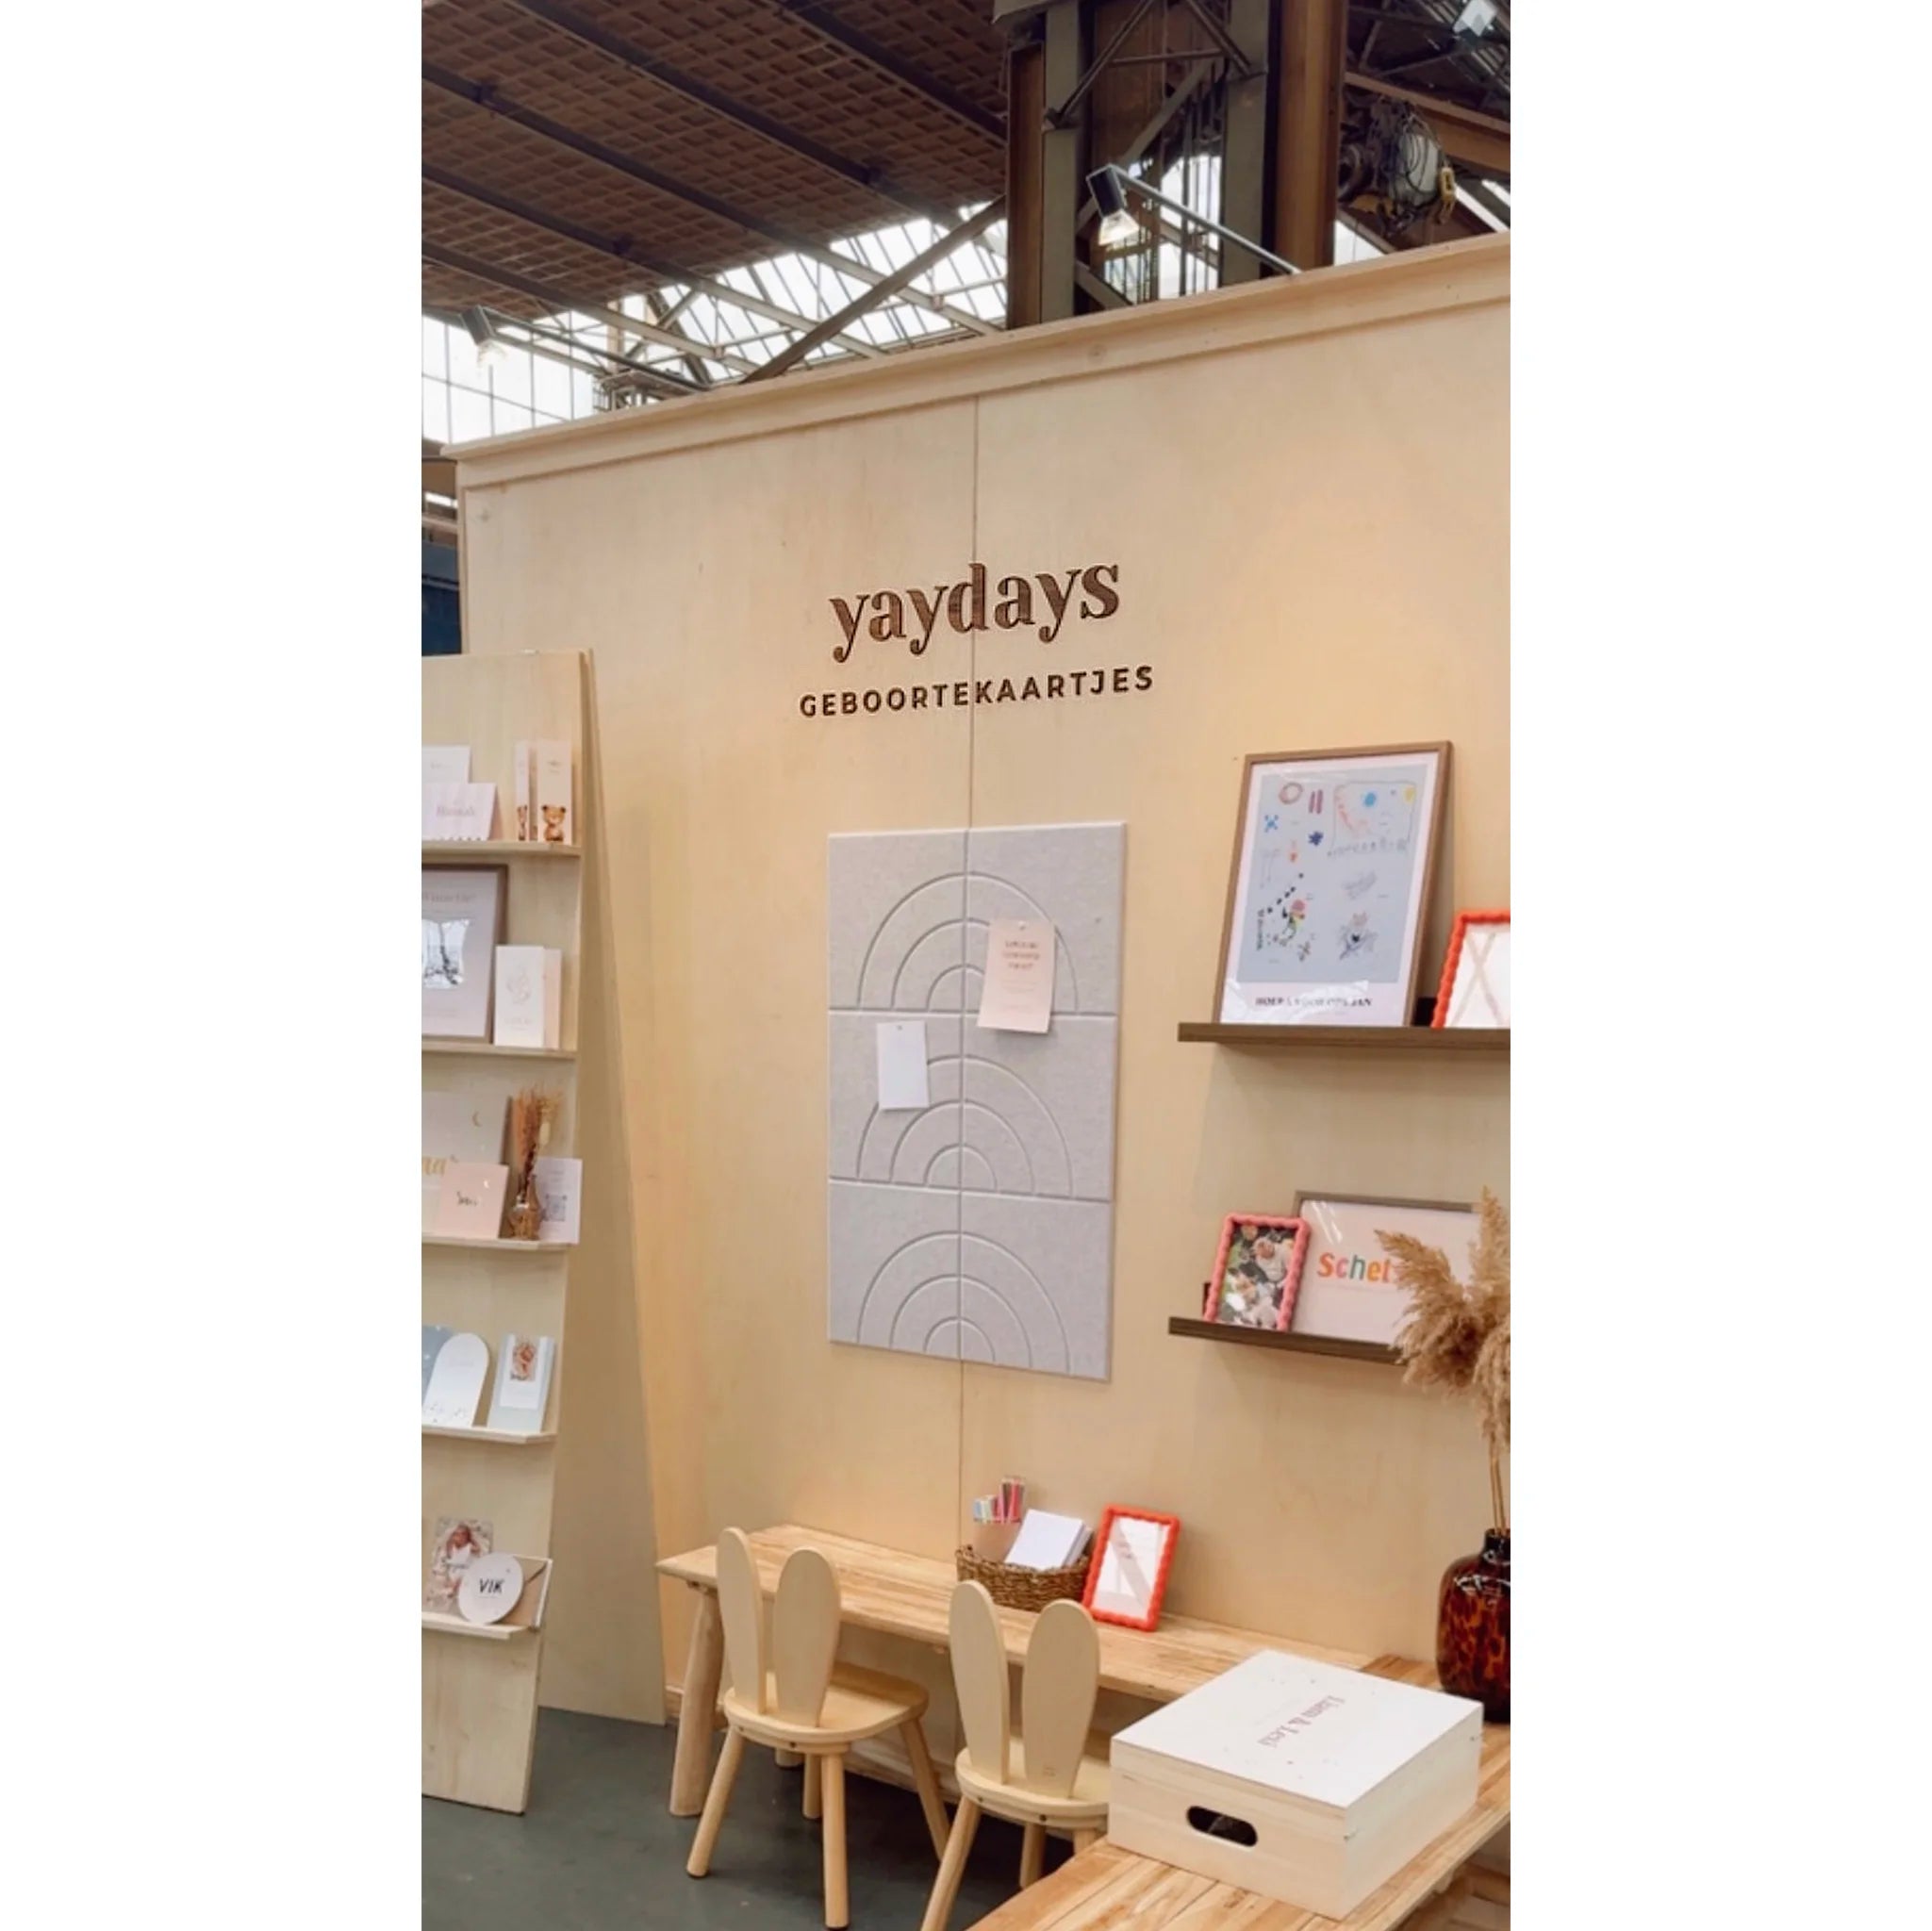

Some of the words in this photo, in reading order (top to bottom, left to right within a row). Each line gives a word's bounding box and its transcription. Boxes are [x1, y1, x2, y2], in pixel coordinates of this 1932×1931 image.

[829, 563, 1120, 663] yaydays
[800, 666, 1153, 717] GEBOORTEKAARTJES
[479, 1578, 504, 1593] VIK
